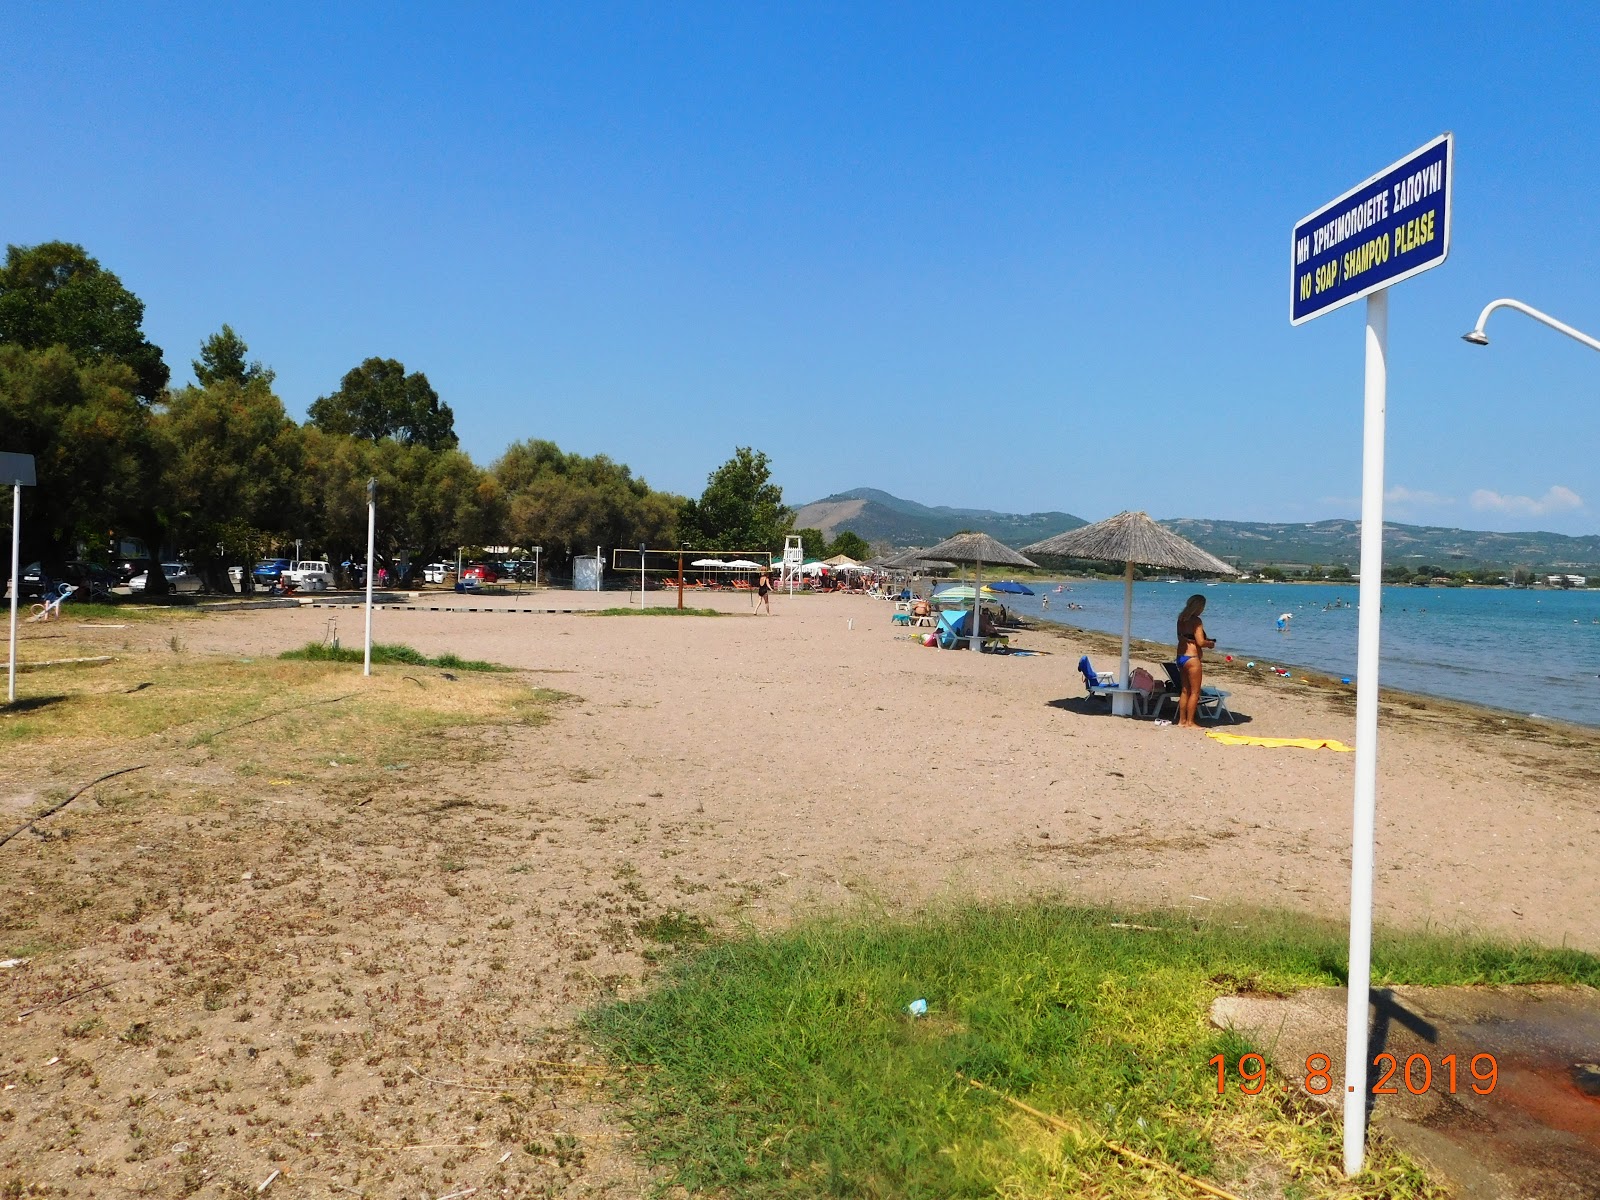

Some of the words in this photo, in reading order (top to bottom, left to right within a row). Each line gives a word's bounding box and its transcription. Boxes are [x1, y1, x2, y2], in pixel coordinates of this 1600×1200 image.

[1297, 235, 1309, 265] ΜΗ
[1312, 189, 1389, 256] ΧΡΗΣΙΜΟΠΟΙΕΙΤΕ
[1393, 160, 1442, 213] ΣΑΠΟΥΝΙ
[1300, 273, 1312, 302] NO
[1394, 210, 1435, 258] PLEASE
